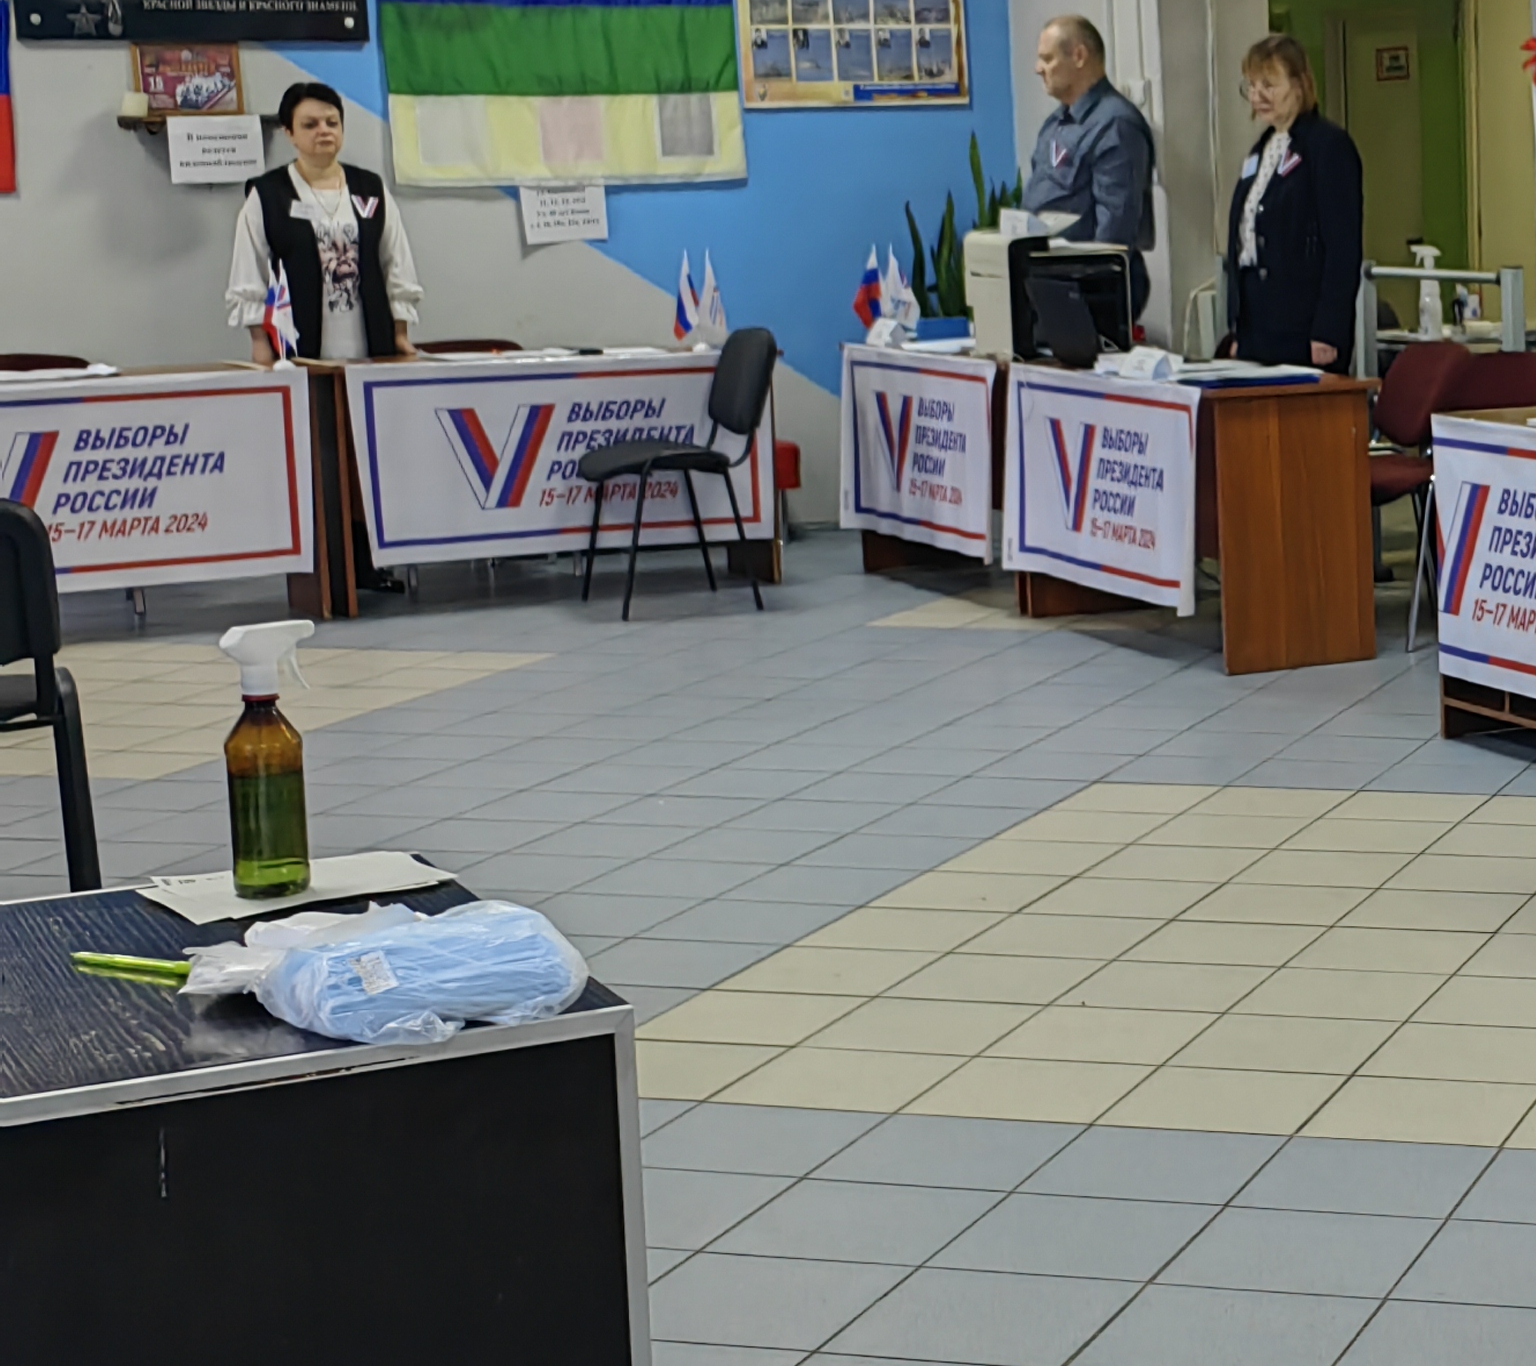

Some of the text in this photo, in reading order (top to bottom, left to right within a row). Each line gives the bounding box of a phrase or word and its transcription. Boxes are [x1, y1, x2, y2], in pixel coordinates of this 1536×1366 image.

[567, 398, 666, 423] ВЫБОРЫ
[917, 397, 955, 422] ВЫБОРЫ
[73, 423, 190, 452] ВЫБОРЫ
[915, 424, 966, 454] ПРЕЗИДЕНТА
[1101, 426, 1149, 456] ВЫБОРЫ
[62, 451, 226, 484] ПРЕЗИДЕНТА
[911, 452, 945, 477] РОССИИ
[1097, 457, 1164, 492] ПРЕЗИДЕНТА
[52, 486, 158, 515] РОССИИ
[1093, 489, 1136, 518] РОССИИ
[99, 516, 160, 540] МАРТА
[164, 512, 208, 534] 2024
[1111, 522, 1137, 545] МАРТА
